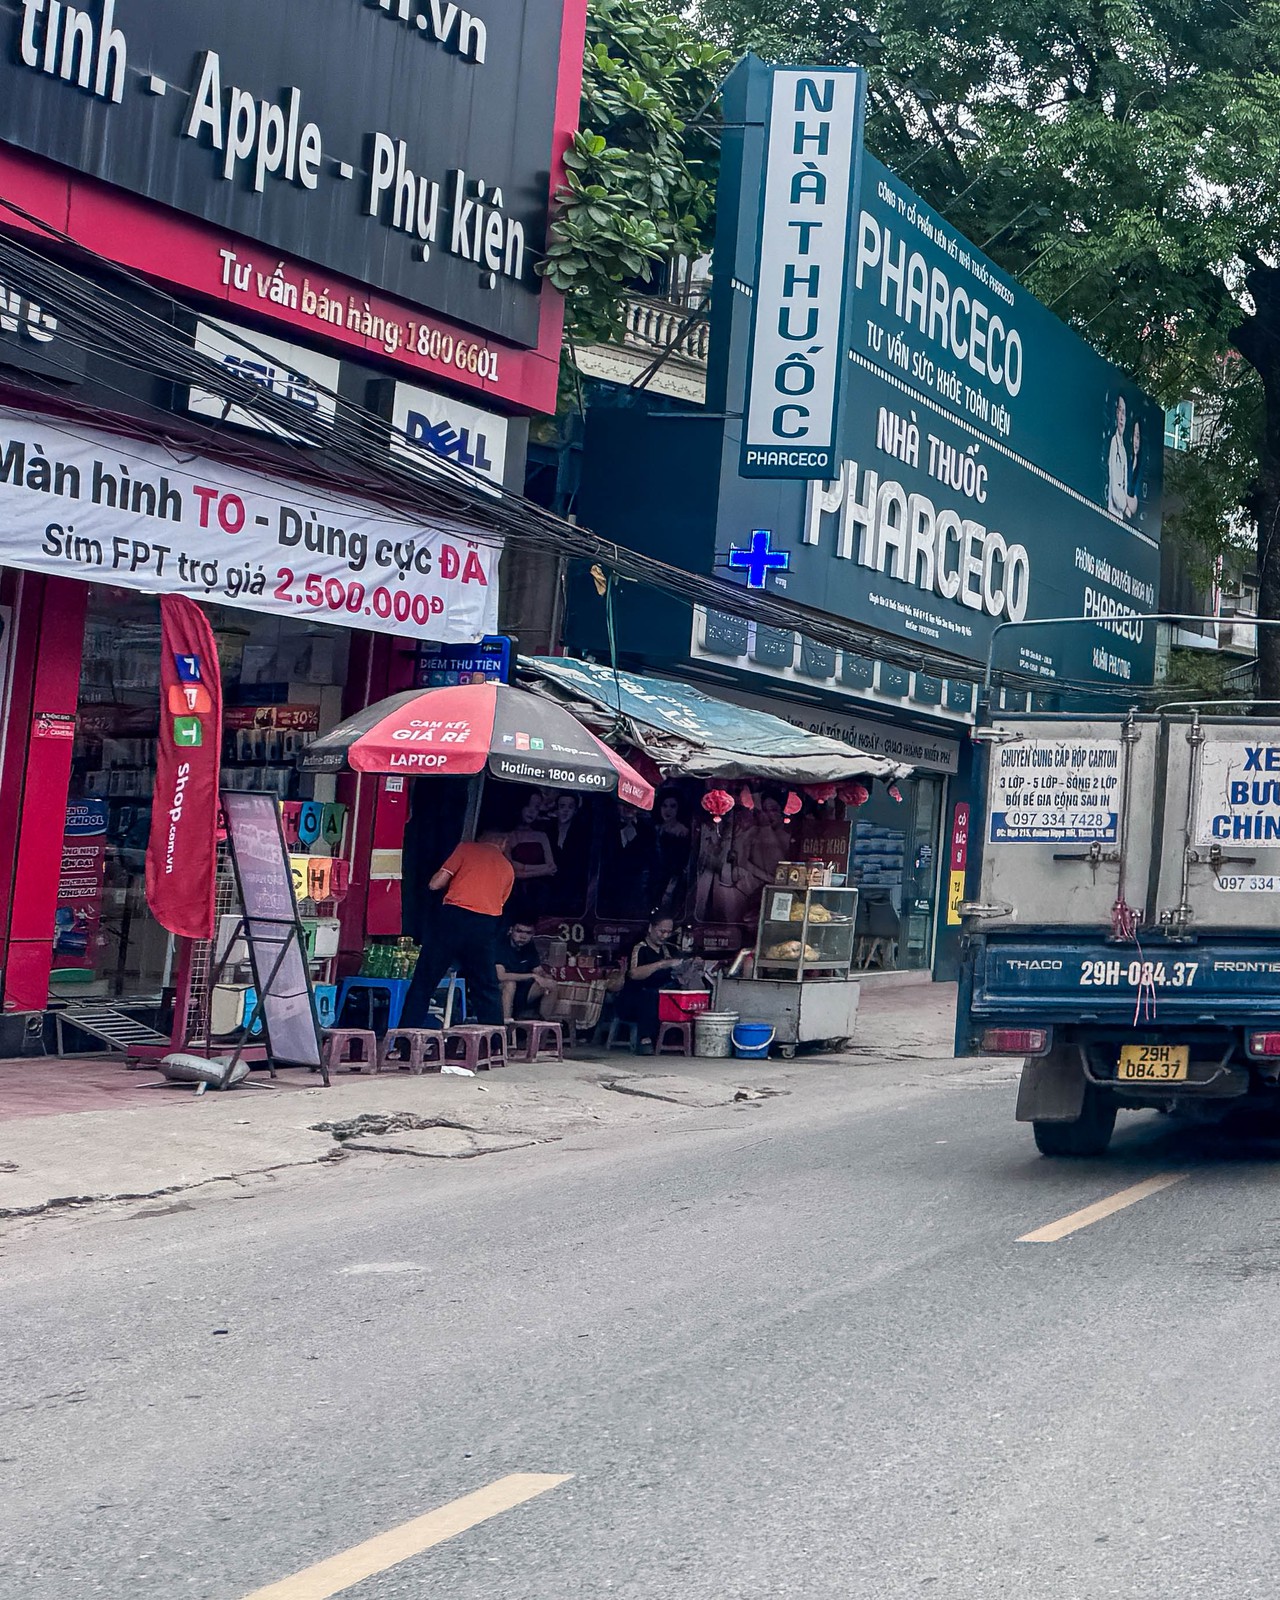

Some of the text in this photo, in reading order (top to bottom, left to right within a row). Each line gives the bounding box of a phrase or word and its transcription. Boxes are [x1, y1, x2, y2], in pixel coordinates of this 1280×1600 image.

[187, 50, 322, 192] Apple
[369, 132, 440, 262] Phụ
[451, 169, 525, 290] kiện
[771, 78, 835, 439] NHÀ THUỐC
[219, 248, 499, 382] Tư vấn bán hàng: 1800 6601
[855, 210, 1024, 398] PHARCECO
[867, 319, 1011, 438] TƯ VẤN SỨC KHỎE TOÀN DIỆN
[407, 410, 492, 472] DELL
[746, 450, 828, 467] PHARCECO
[876, 406, 988, 503] NHÀ THUỐC
[0, 440, 488, 586] Màn hình TO Dùng cực ĐÃ
[803, 459, 1030, 623] PHARCECO
[42, 523, 102, 565] Sim
[112, 536, 171, 577] FPT
[178, 552, 219, 594] trợ
[224, 562, 267, 598] giá
[1075, 547, 1095, 575] PHÒNG
[1084, 586, 1144, 644] PHARCECO
[450, 658, 474, 671] THU
[391, 727, 471, 743] GIÁ RẺ
[390, 753, 447, 767] LAPTOP
[1032, 748, 1053, 768] CUNG
[1088, 749, 1118, 768] CARTON
[501, 760, 607, 787] Hotline: 1800 6601
[1000, 777, 1006, 789] 3
[1033, 777, 1039, 789] 5
[1093, 777, 1099, 789] 2
[1037, 794, 1052, 806] GIA
[1080, 794, 1098, 806] SAU
[1100, 794, 1110, 806] IN
[1013, 812, 1103, 826] 097 334 7428
[1220, 876, 1246, 892] 097
[1249, 876, 1275, 892] 334
[1006, 959, 1062, 970] THACO
[1079, 961, 1199, 987] 29H-084.37
[1139, 1048, 1169, 1062] 29H
[1126, 1064, 1181, 1079] 084.37
